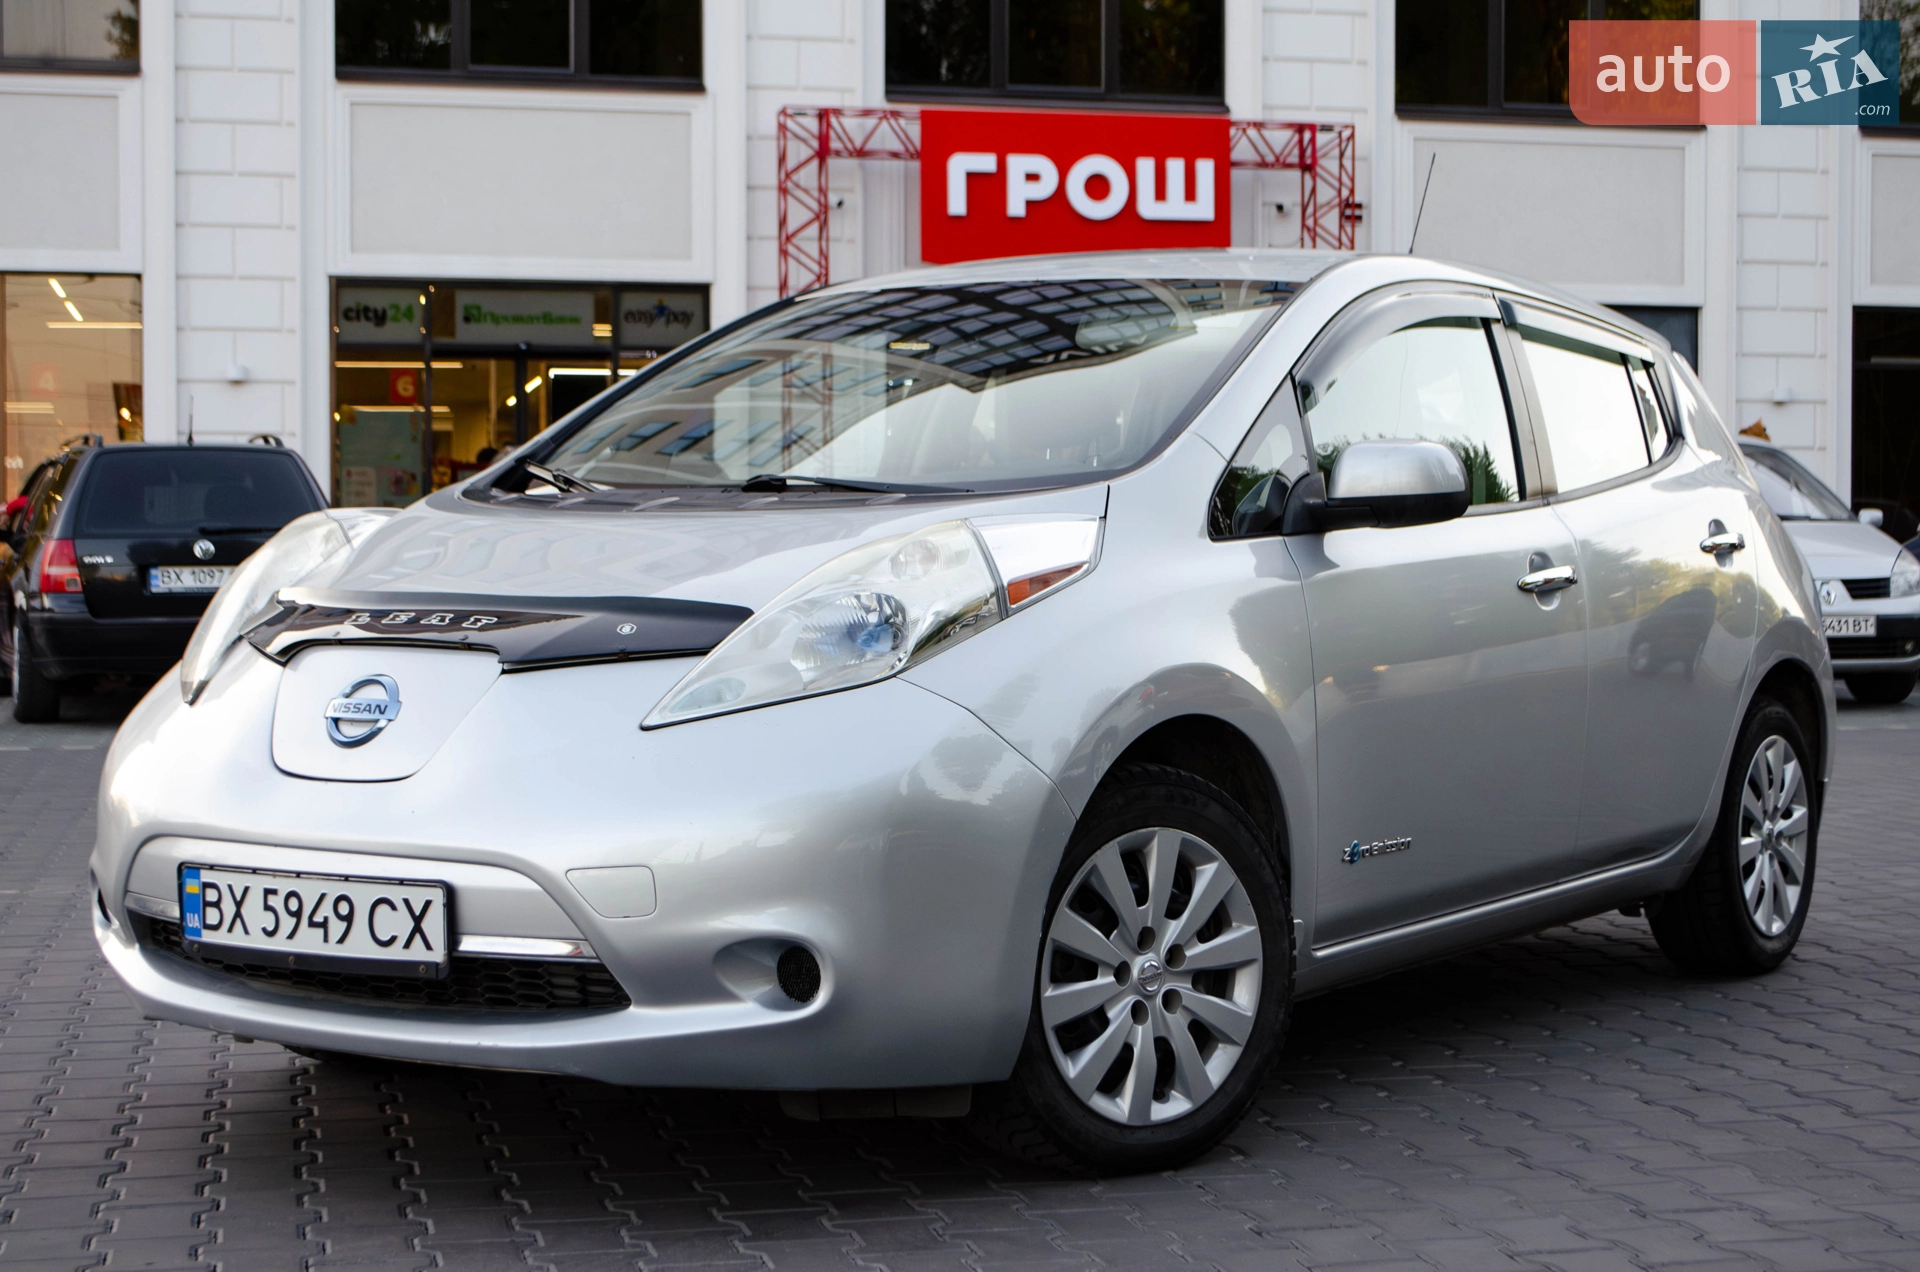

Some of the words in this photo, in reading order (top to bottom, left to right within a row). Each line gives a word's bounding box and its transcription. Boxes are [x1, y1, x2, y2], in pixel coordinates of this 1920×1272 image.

[946, 151, 1215, 222] ГРОШ
[342, 302, 415, 327] city24
[395, 374, 416, 398] 6
[161, 568, 185, 586] BX
[191, 569, 225, 586] 1097
[344, 612, 498, 629] LEAF
[1852, 619, 1869, 633] BT
[329, 702, 389, 716] NISSAN
[186, 912, 201, 930] UA
[201, 880, 252, 936] BX
[260, 886, 356, 945] 5949
[367, 896, 435, 952] CX
